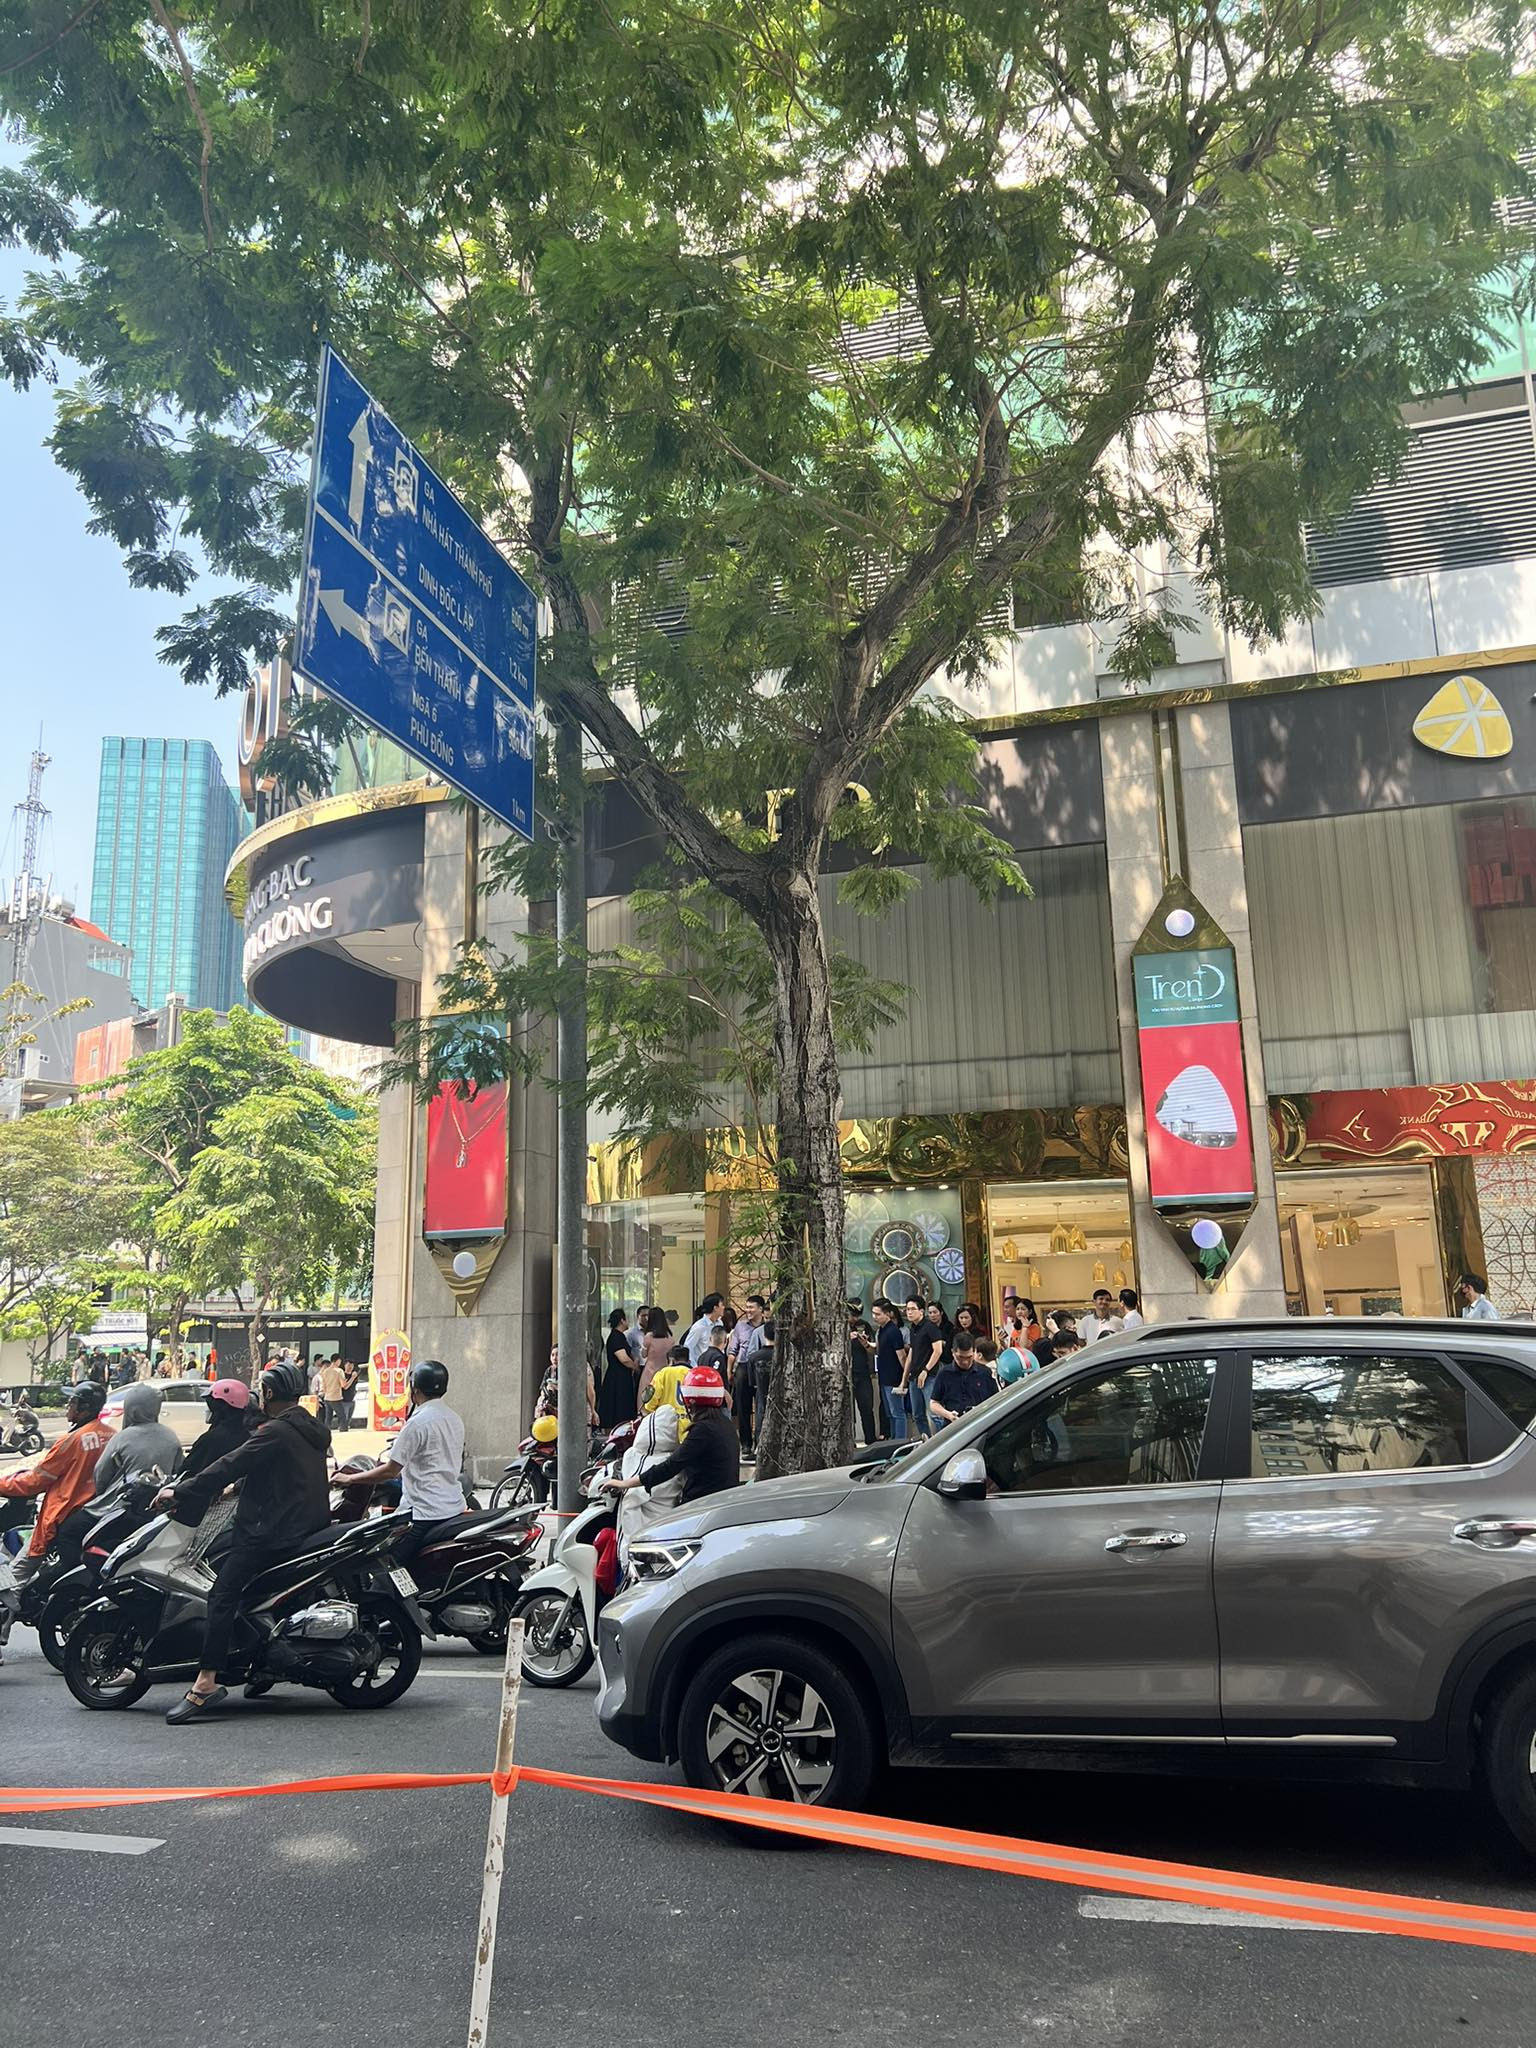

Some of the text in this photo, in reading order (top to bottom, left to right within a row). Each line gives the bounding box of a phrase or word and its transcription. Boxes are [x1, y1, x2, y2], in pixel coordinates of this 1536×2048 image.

[423, 481, 435, 505] GA
[422, 505, 438, 538] NHÀ
[438, 526, 454, 555] HÁT
[478, 569, 494, 598] PHỐ
[418, 562, 438, 600] DINH
[416, 619, 428, 642] GA
[431, 708, 438, 722] 6
[410, 718, 429, 748] PHÙ
[268, 855, 313, 901] BẠC
